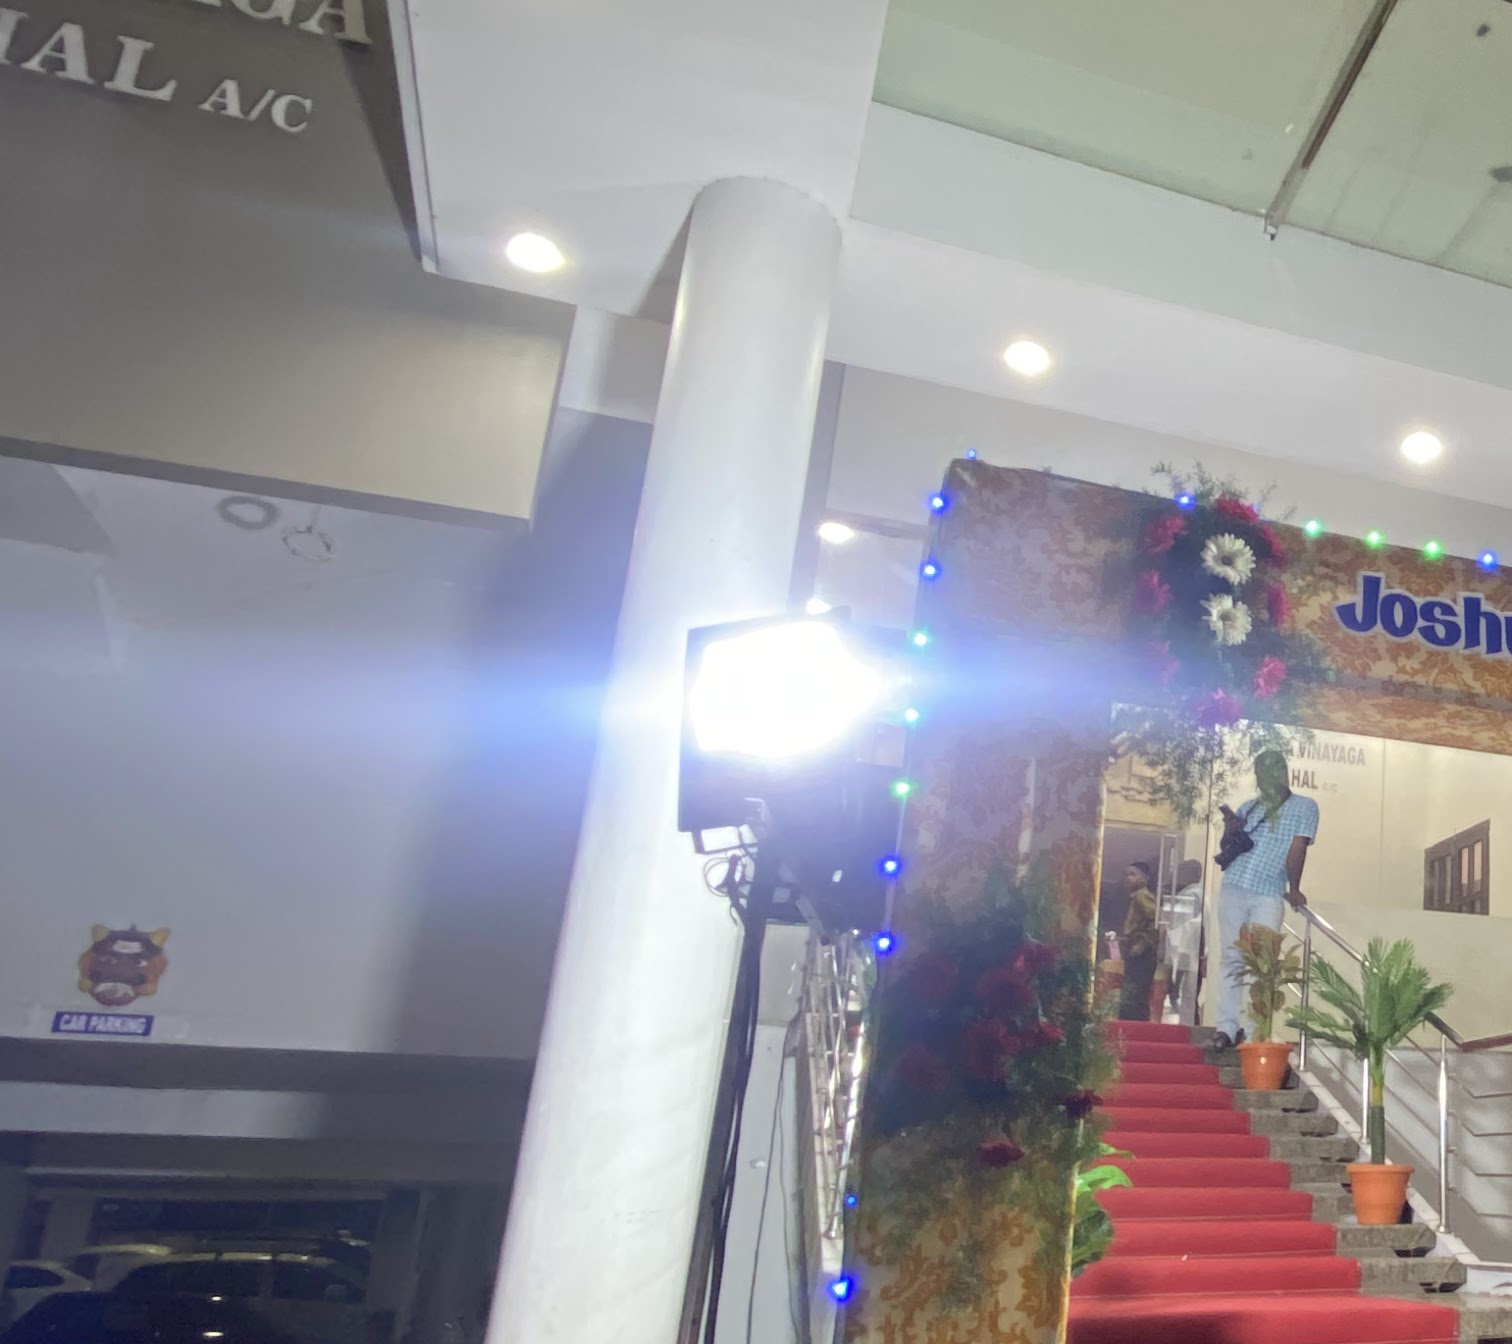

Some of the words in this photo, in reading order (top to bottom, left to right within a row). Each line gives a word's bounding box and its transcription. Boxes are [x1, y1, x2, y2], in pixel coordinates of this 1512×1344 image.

[198, 78, 313, 133] A/C
[1299, 741, 1366, 766] VINAYAGA
[59, 1014, 87, 1031] CAR
[88, 1015, 147, 1034] PARKING
